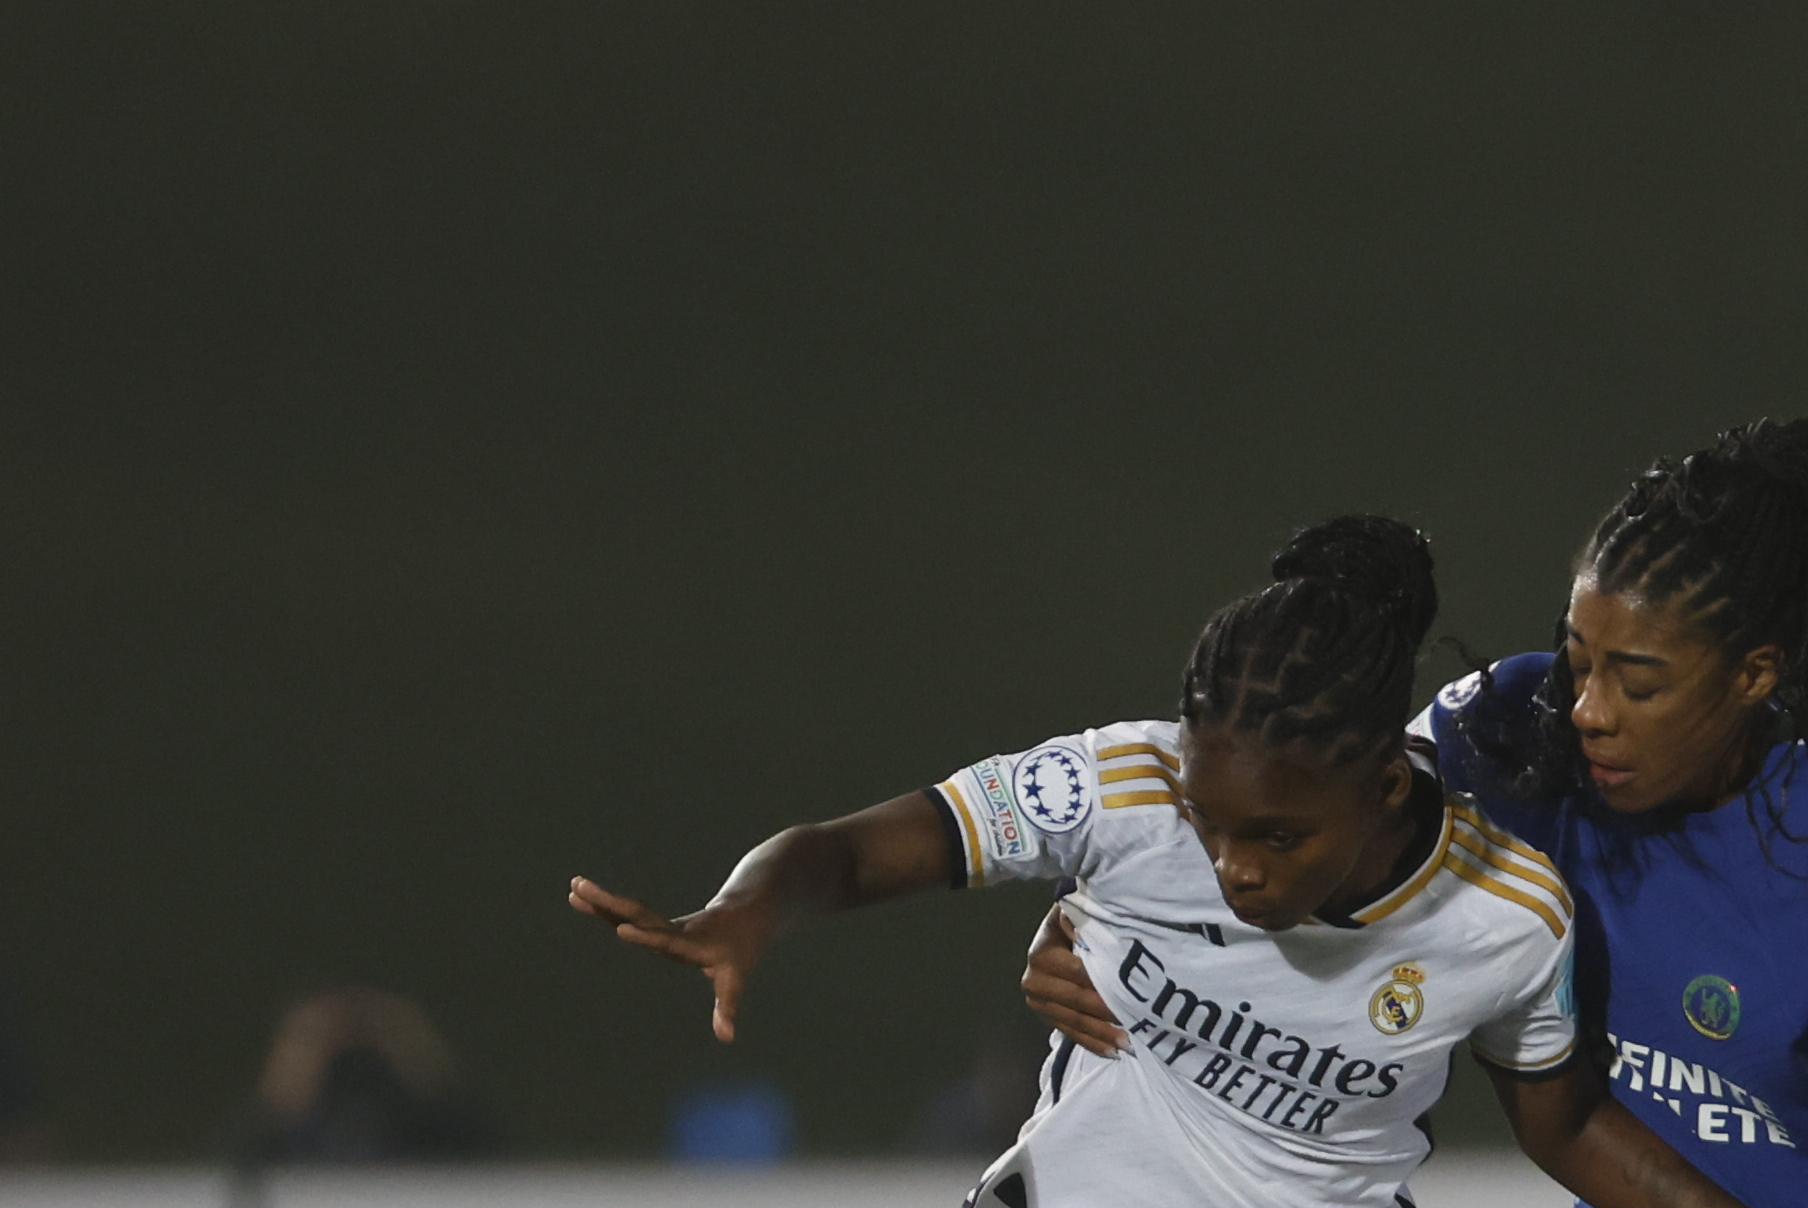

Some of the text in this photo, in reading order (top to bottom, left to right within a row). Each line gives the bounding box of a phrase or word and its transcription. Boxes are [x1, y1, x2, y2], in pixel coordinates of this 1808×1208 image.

[974, 760, 1021, 856] OUNDATION
[1118, 937, 1404, 1099] Emirates
[1192, 1053, 1340, 1135] BETTER
[1607, 1032, 1783, 1127] FINITE
